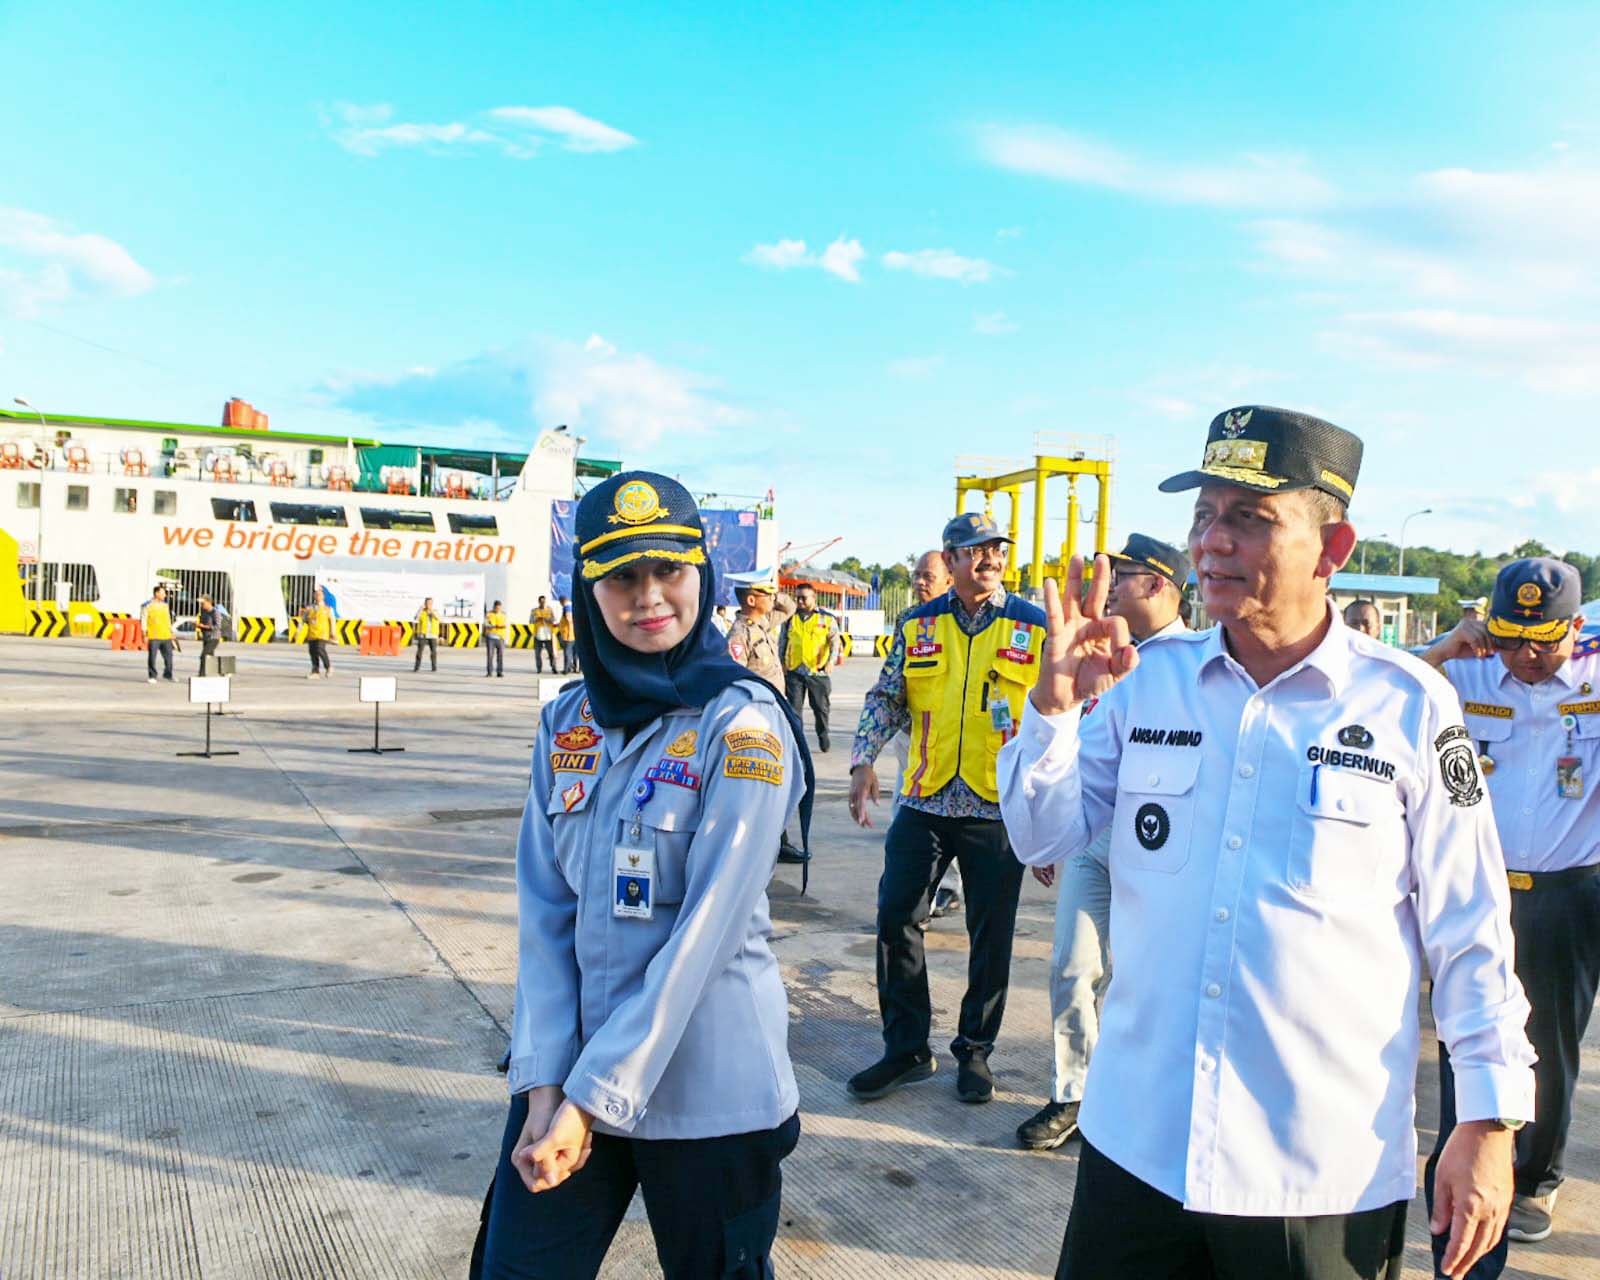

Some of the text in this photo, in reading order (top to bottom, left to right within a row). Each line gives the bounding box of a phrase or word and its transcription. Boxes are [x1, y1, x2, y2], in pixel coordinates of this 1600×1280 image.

[163, 523, 515, 564] we bridge the nation
[912, 645, 936, 655] DJBM
[1466, 703, 1511, 717] JUNAIDI
[1128, 726, 1202, 747] ANSAR AHMAD
[553, 753, 587, 769] DINI
[1307, 745, 1396, 781] GUBERNUR
